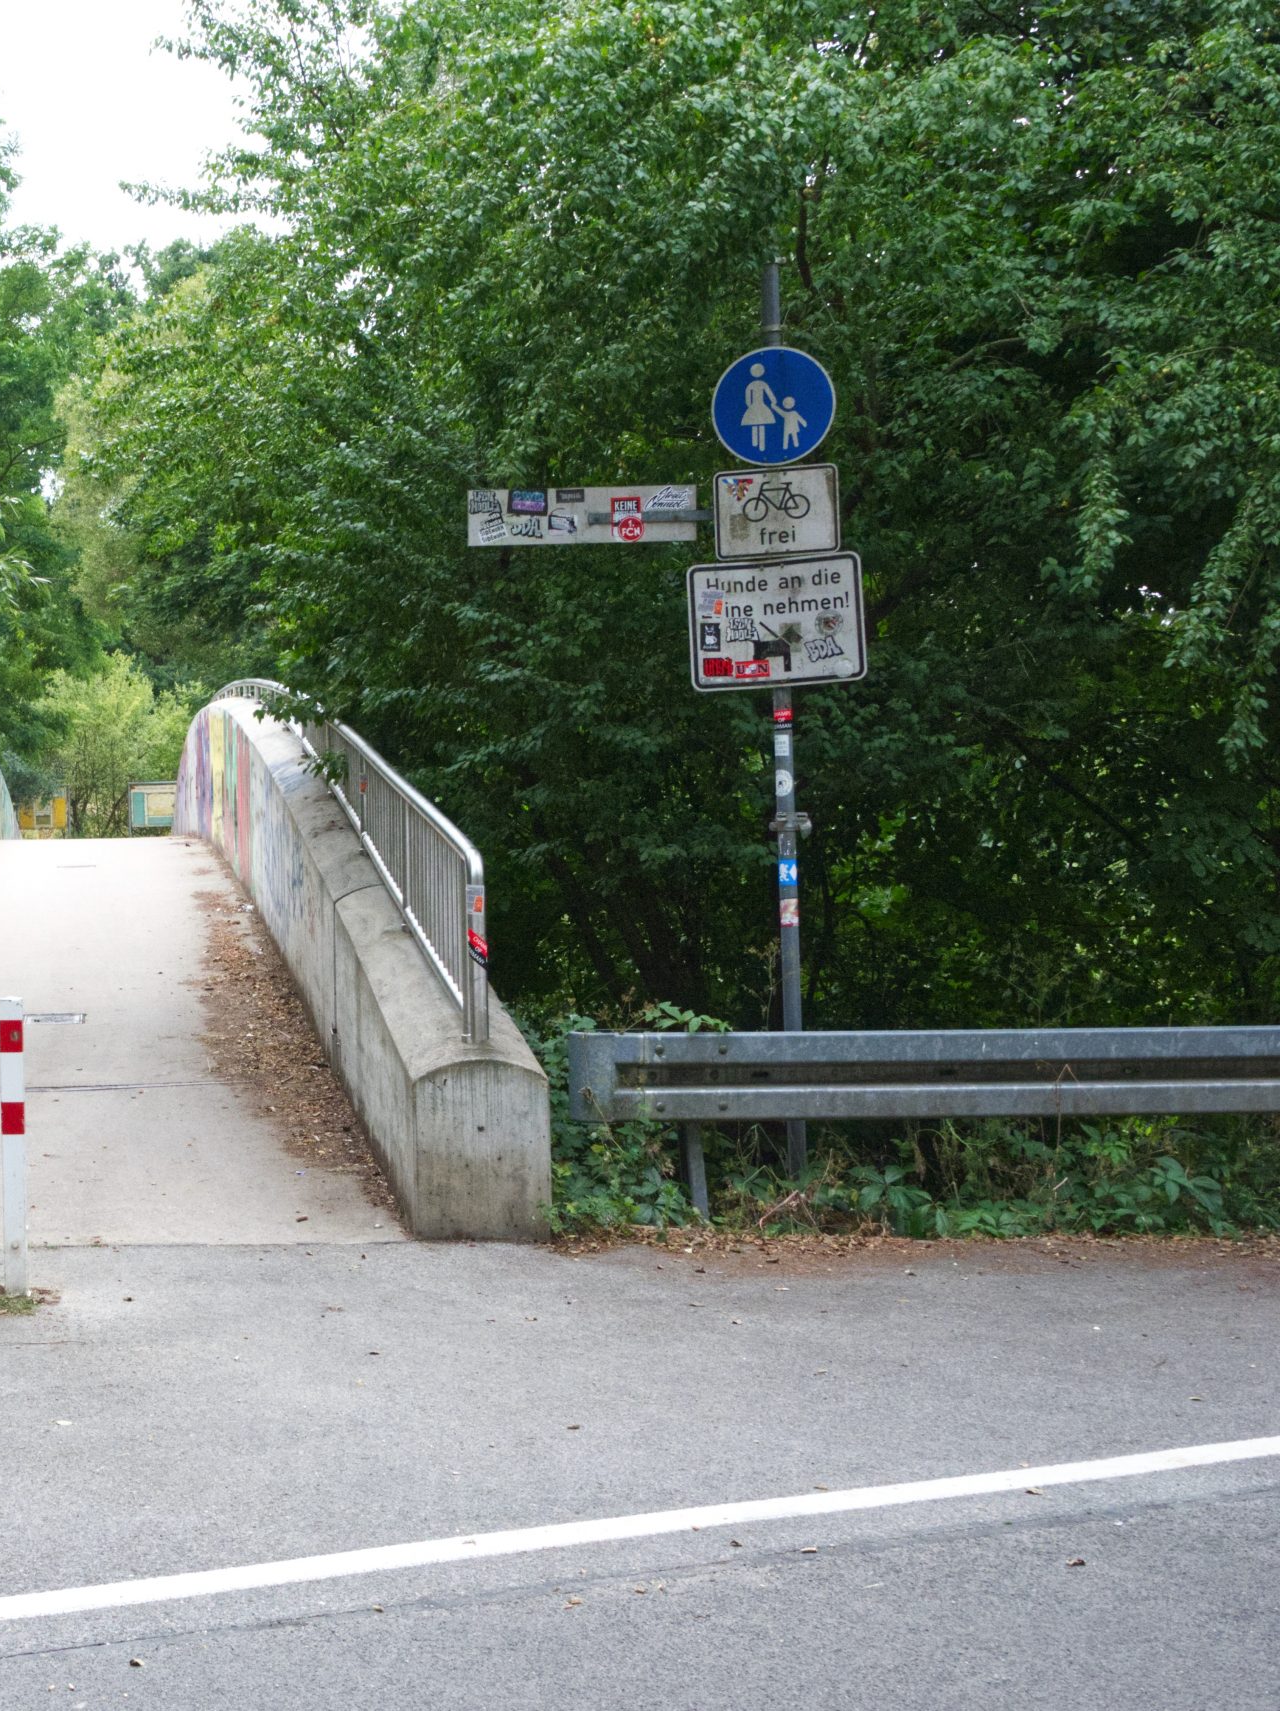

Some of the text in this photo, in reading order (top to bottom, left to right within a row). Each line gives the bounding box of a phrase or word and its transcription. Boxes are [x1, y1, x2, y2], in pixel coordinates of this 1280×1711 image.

[614, 500, 638, 511] KEINE
[621, 527, 640, 537] FCN
[627, 520, 635, 528] 1.
[759, 525, 796, 546] frei
[706, 569, 841, 594] Hunde an die
[763, 592, 850, 616] nehmen!
[804, 634, 844, 662] BDA
